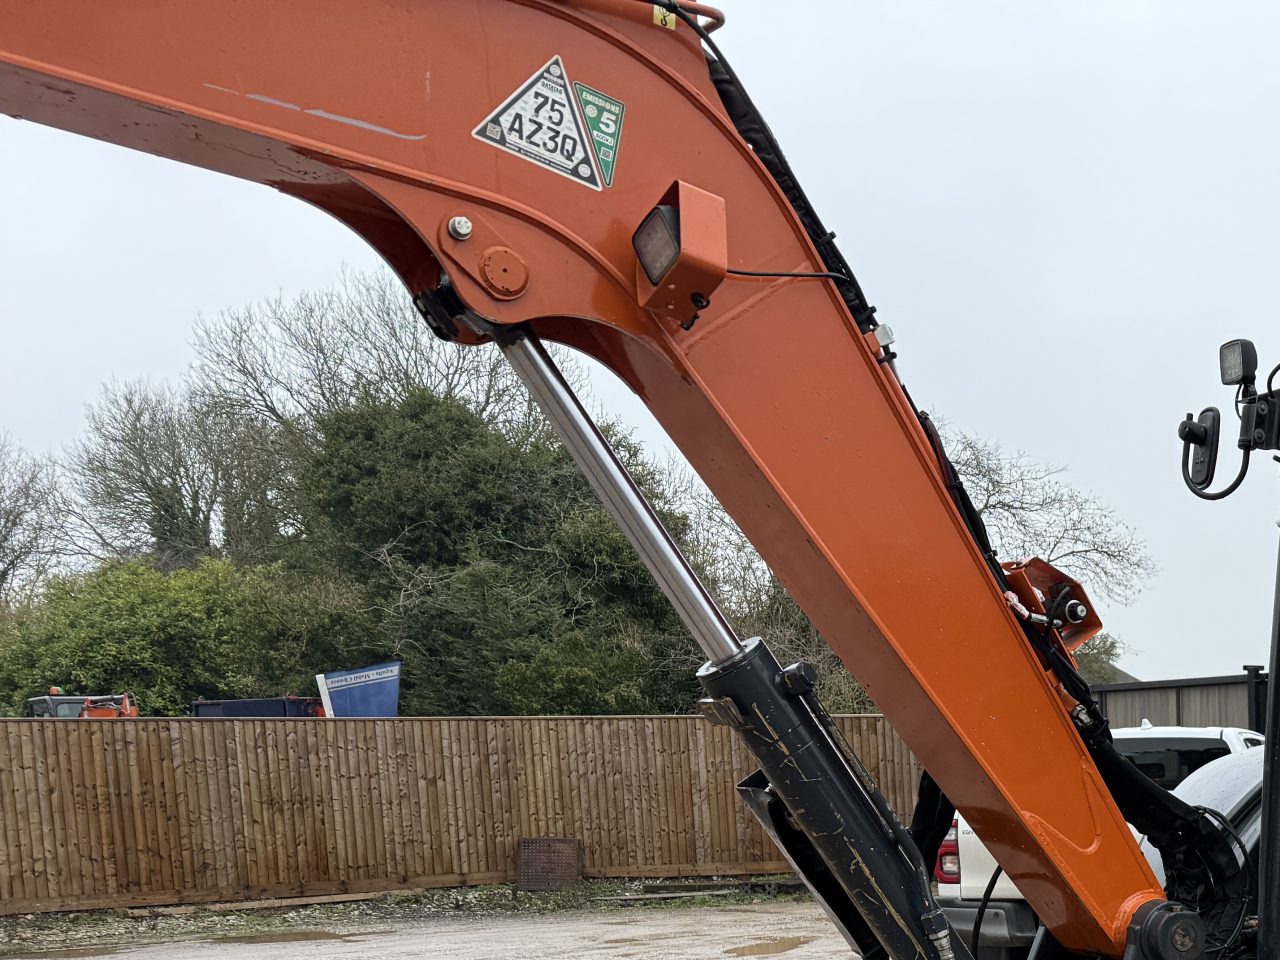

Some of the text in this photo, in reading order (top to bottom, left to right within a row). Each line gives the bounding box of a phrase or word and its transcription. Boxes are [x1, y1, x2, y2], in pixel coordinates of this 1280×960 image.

[532, 90, 566, 127] 75
[582, 91, 620, 114] EMISSIONS
[507, 112, 578, 163] AZ3Q
[599, 111, 616, 134] 5
